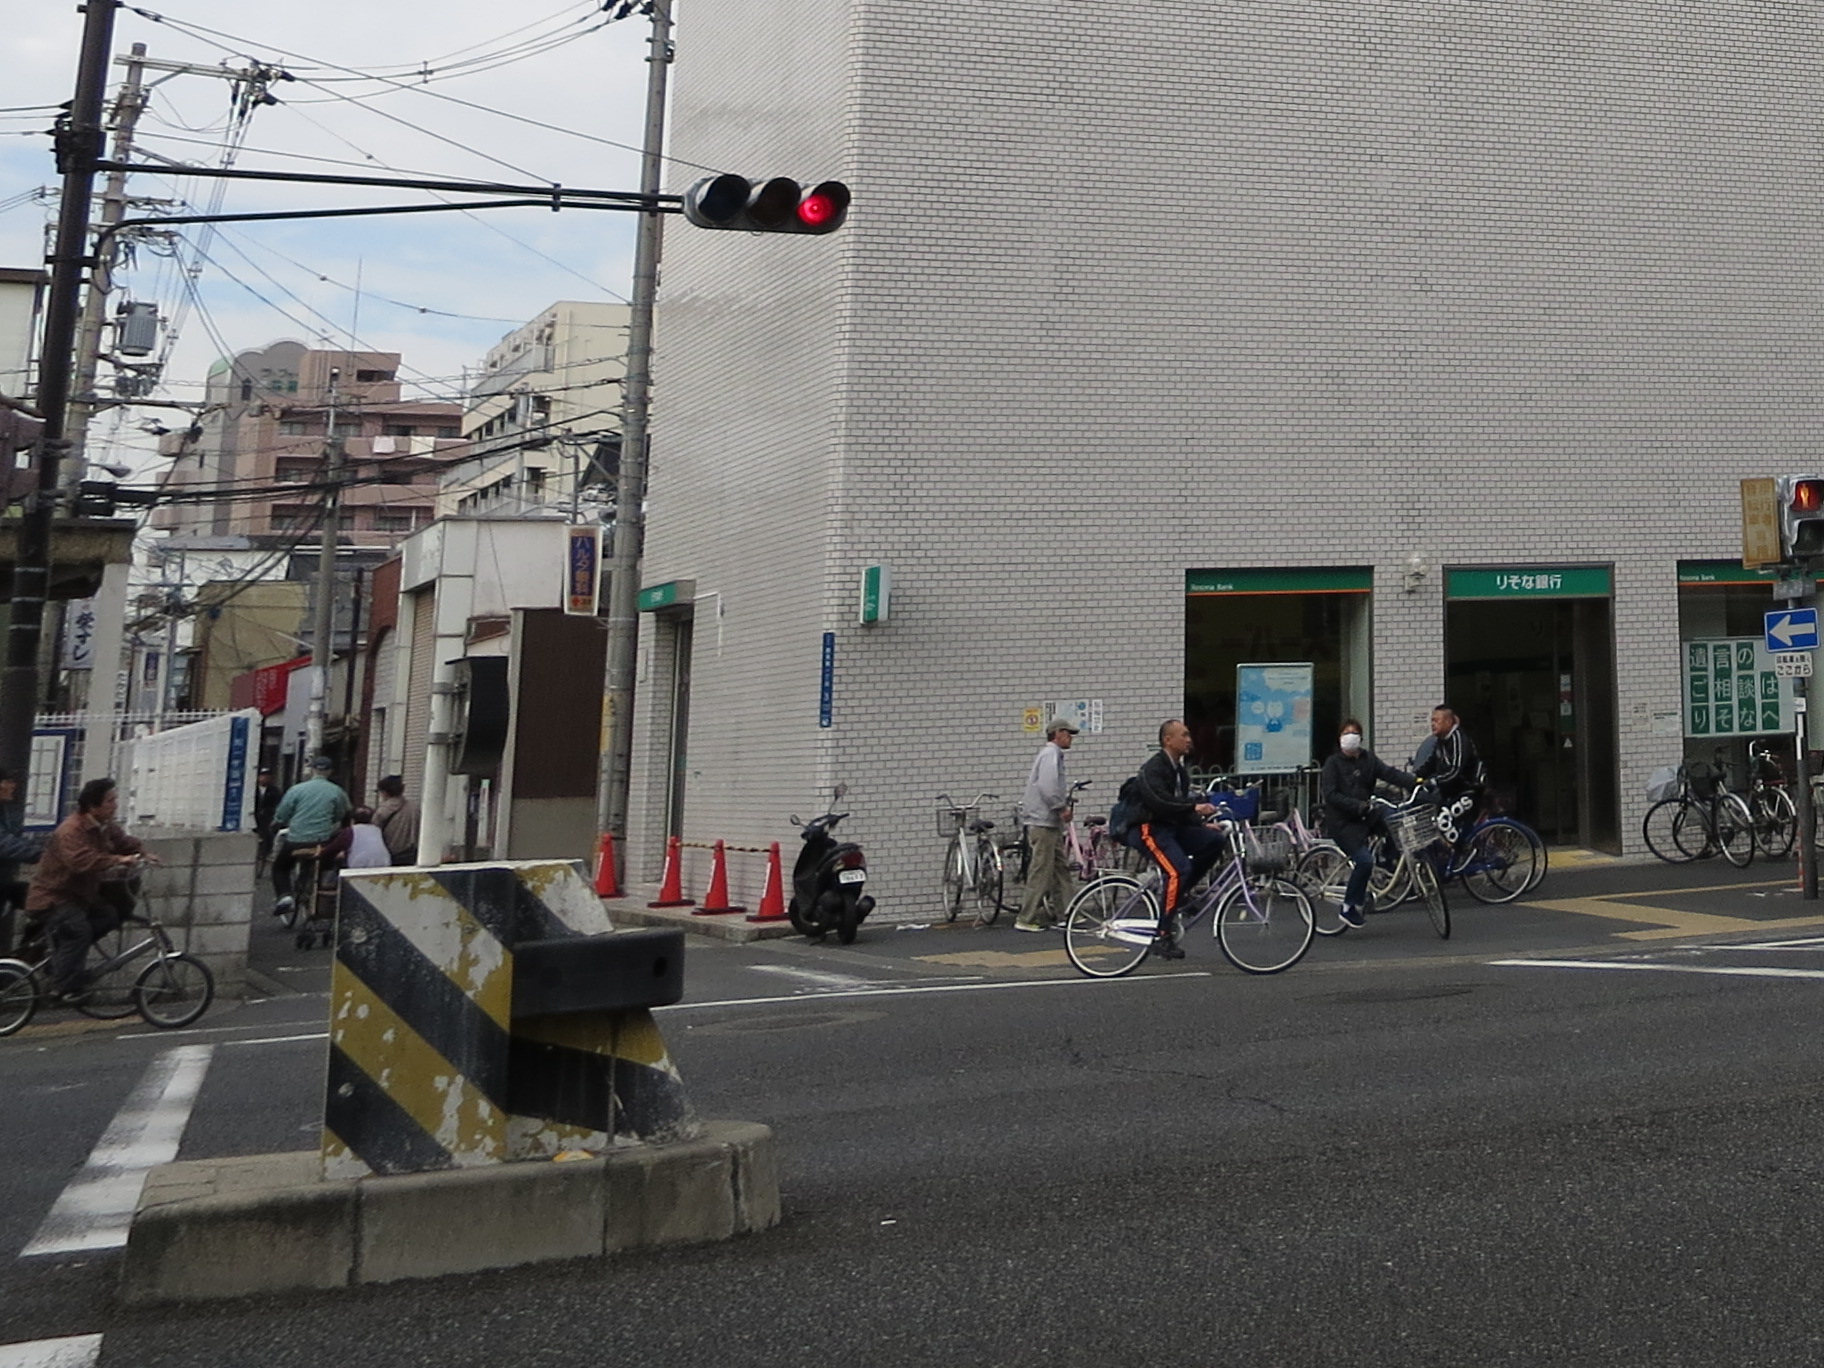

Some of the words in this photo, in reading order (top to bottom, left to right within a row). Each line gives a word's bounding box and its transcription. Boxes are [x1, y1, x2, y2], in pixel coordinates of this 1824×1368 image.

[1496, 574, 1562, 590] りそな銀行
[1689, 647, 1754, 669] 遺言の
[1777, 664, 1811, 676] ここから
[1691, 676, 1779, 699] ご相談は
[1694, 708, 1779, 729] りそなへ
